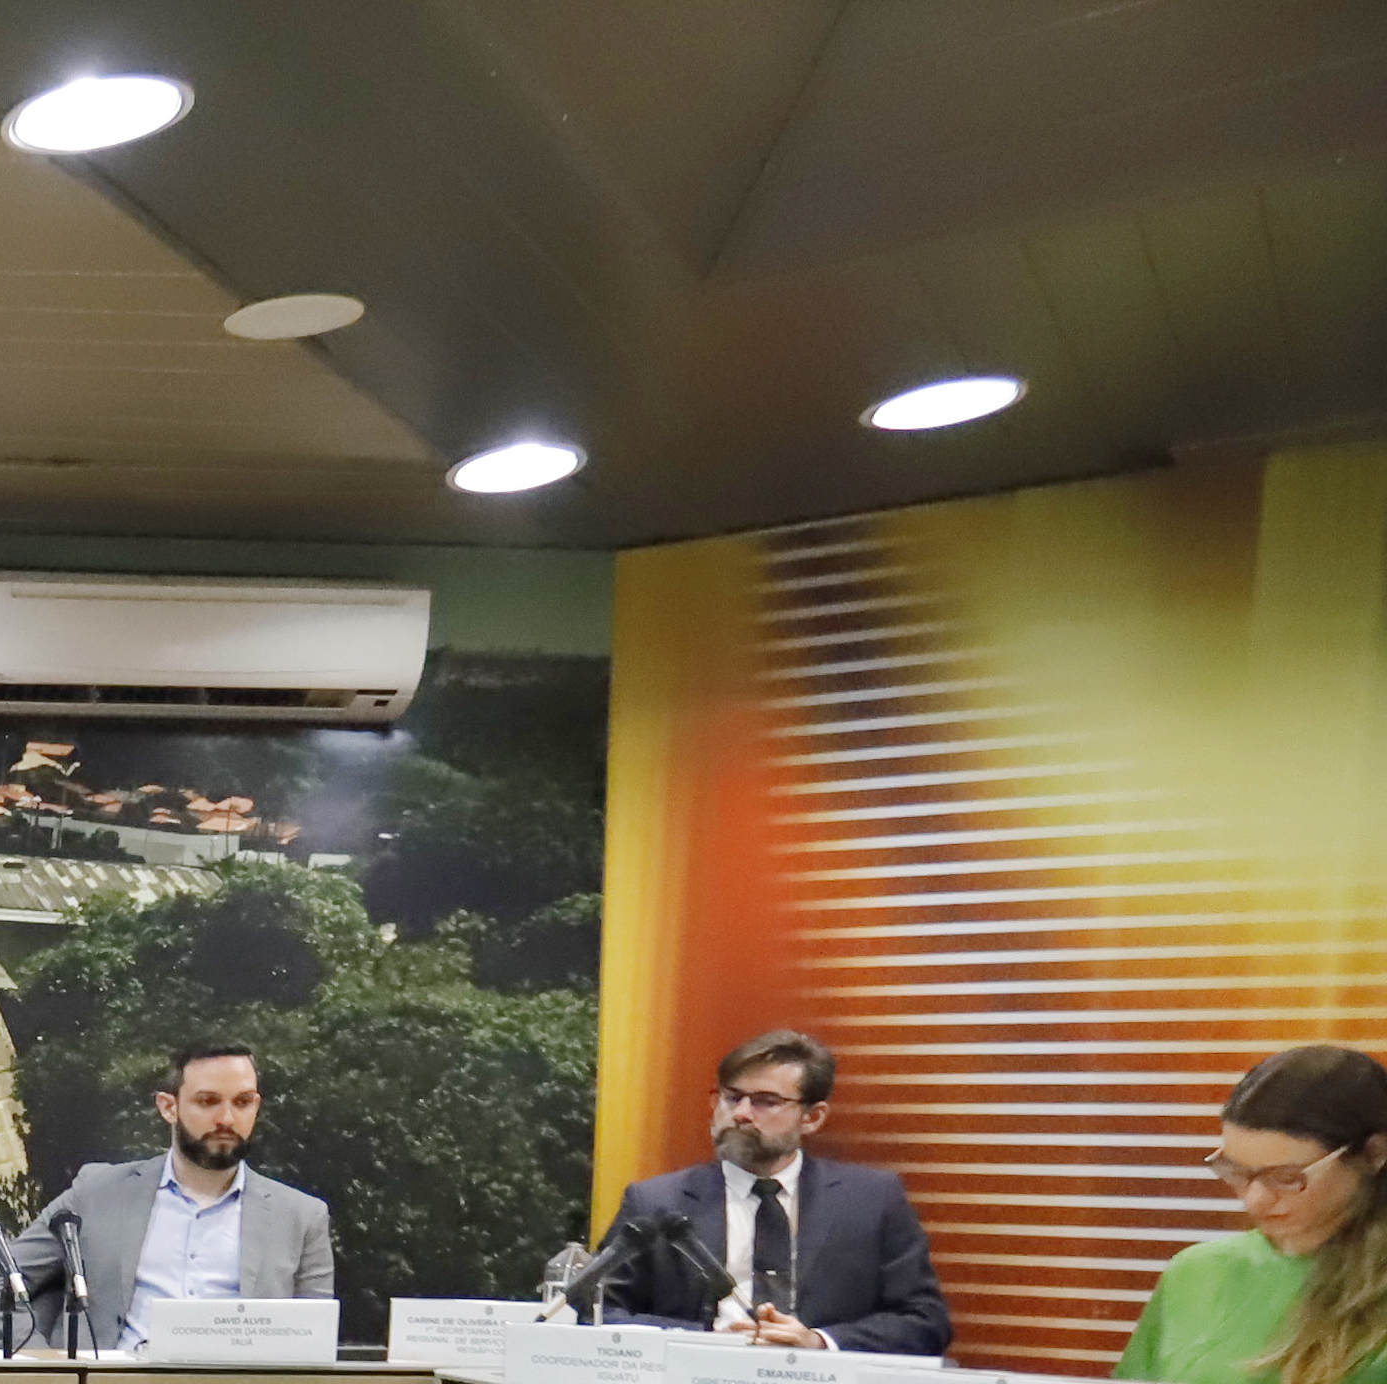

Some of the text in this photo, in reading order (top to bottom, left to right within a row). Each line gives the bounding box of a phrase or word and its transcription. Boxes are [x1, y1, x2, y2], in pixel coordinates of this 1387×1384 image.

[214, 1317, 272, 1325] DAVID ALVES
[172, 1327, 242, 1336] COORDENADOR
[245, 1328, 257, 1336] DA
[597, 1347, 643, 1358] TICIANO
[531, 1354, 618, 1369] COORDENADOR
[622, 1361, 638, 1370] DA
[757, 1368, 837, 1383] EMANUELLA
